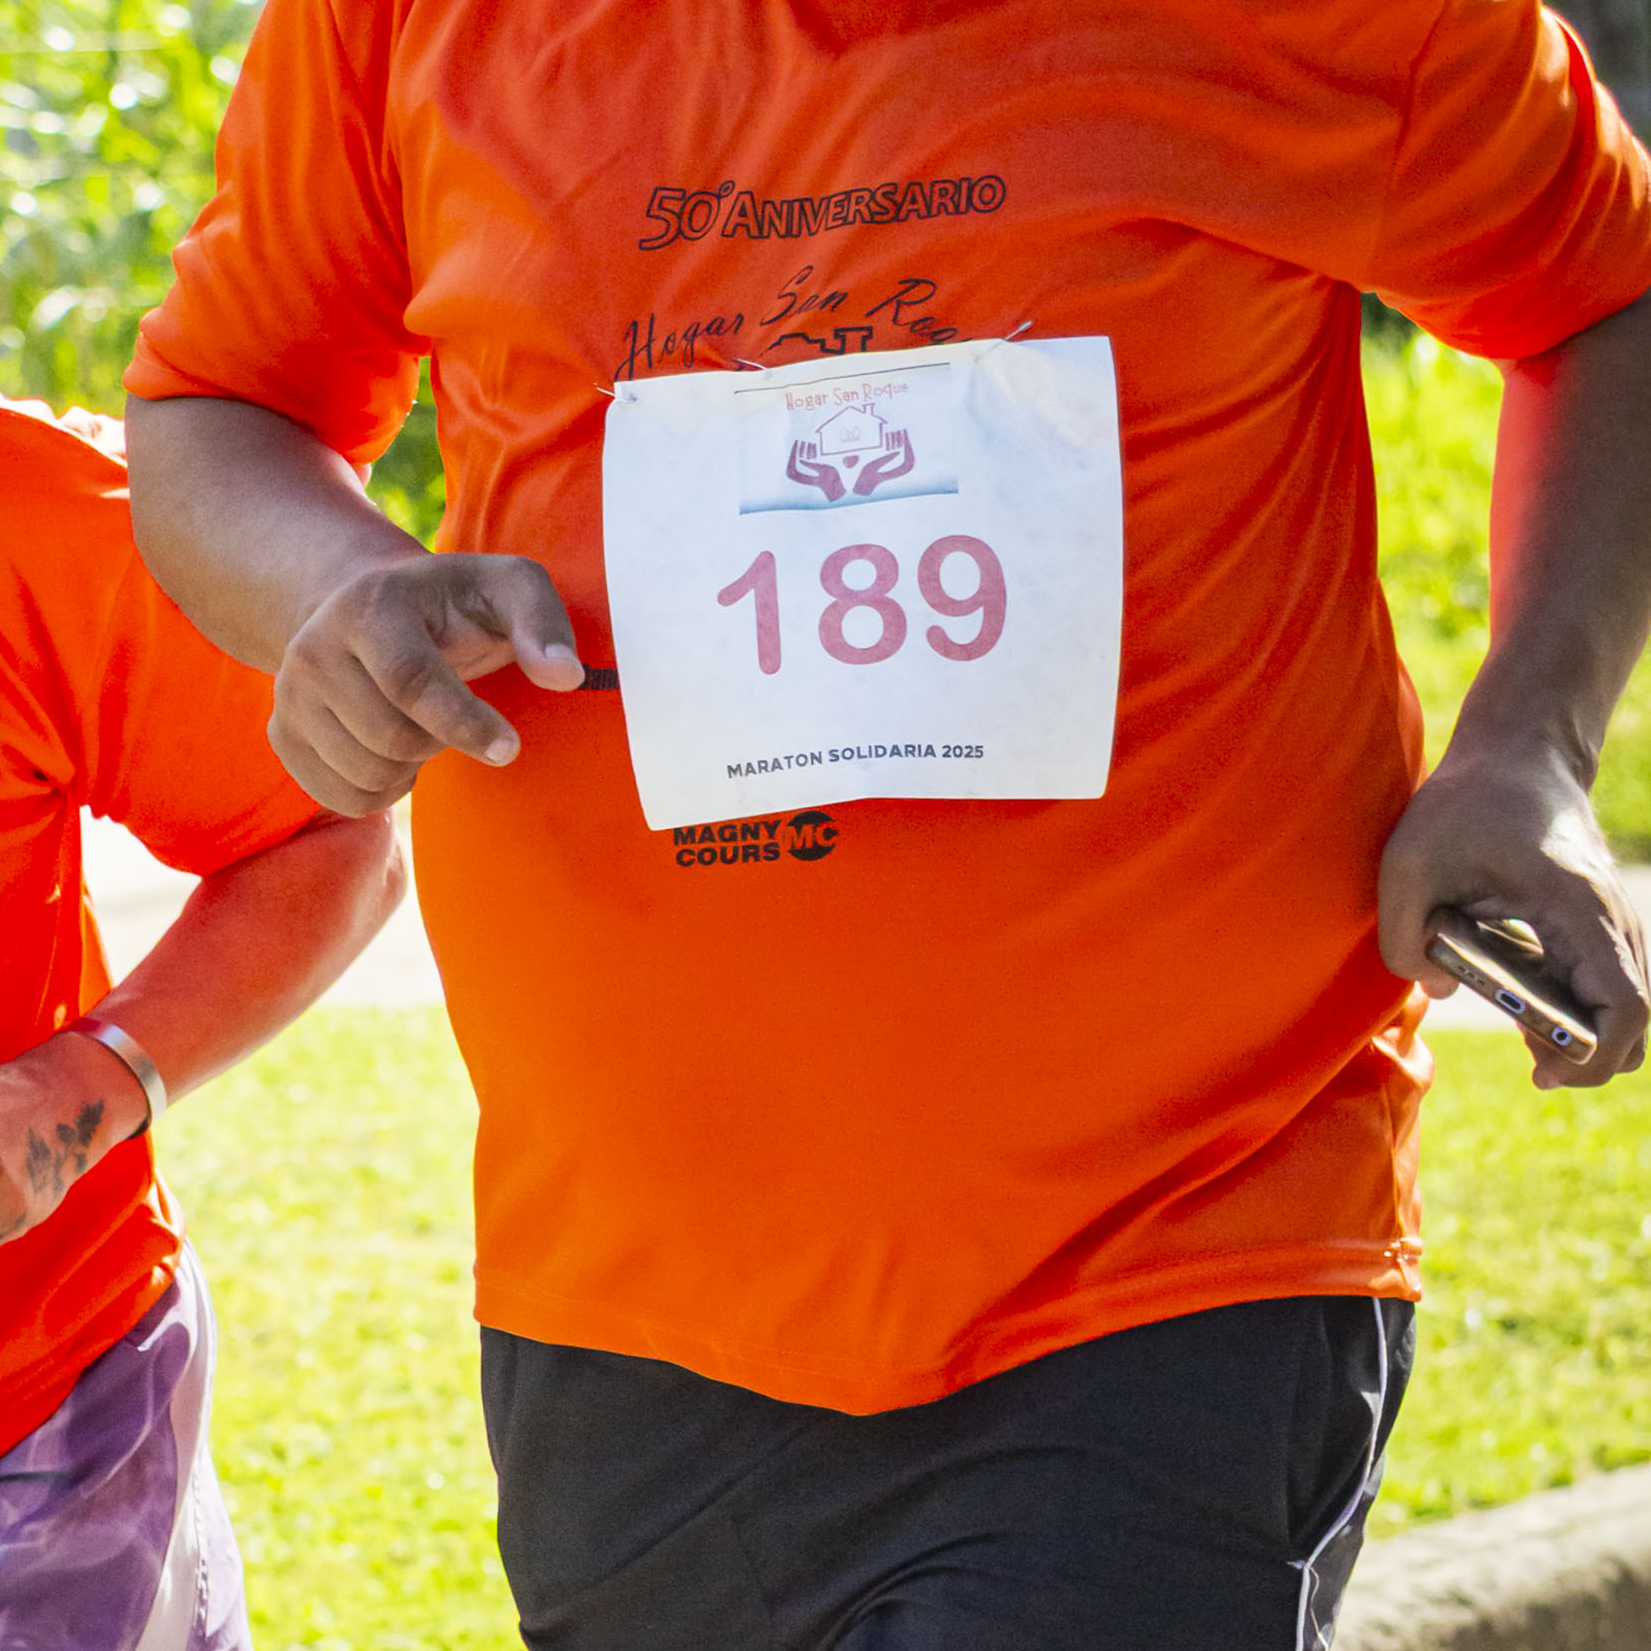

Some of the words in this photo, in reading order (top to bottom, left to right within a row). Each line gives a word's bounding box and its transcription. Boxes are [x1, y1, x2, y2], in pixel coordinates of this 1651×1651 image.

[613, 312, 745, 381] Hogar
[759, 264, 849, 327] San
[784, 392, 829, 411] Hogar
[832, 387, 860, 406] San
[861, 382, 909, 401] Roque
[716, 534, 1008, 675] 189
[726, 751, 823, 779] MARATON
[827, 743, 937, 763] SOLIDARIA
[941, 744, 985, 759] 2025
[673, 820, 782, 846] MAGNY
[676, 841, 782, 867] COURS
